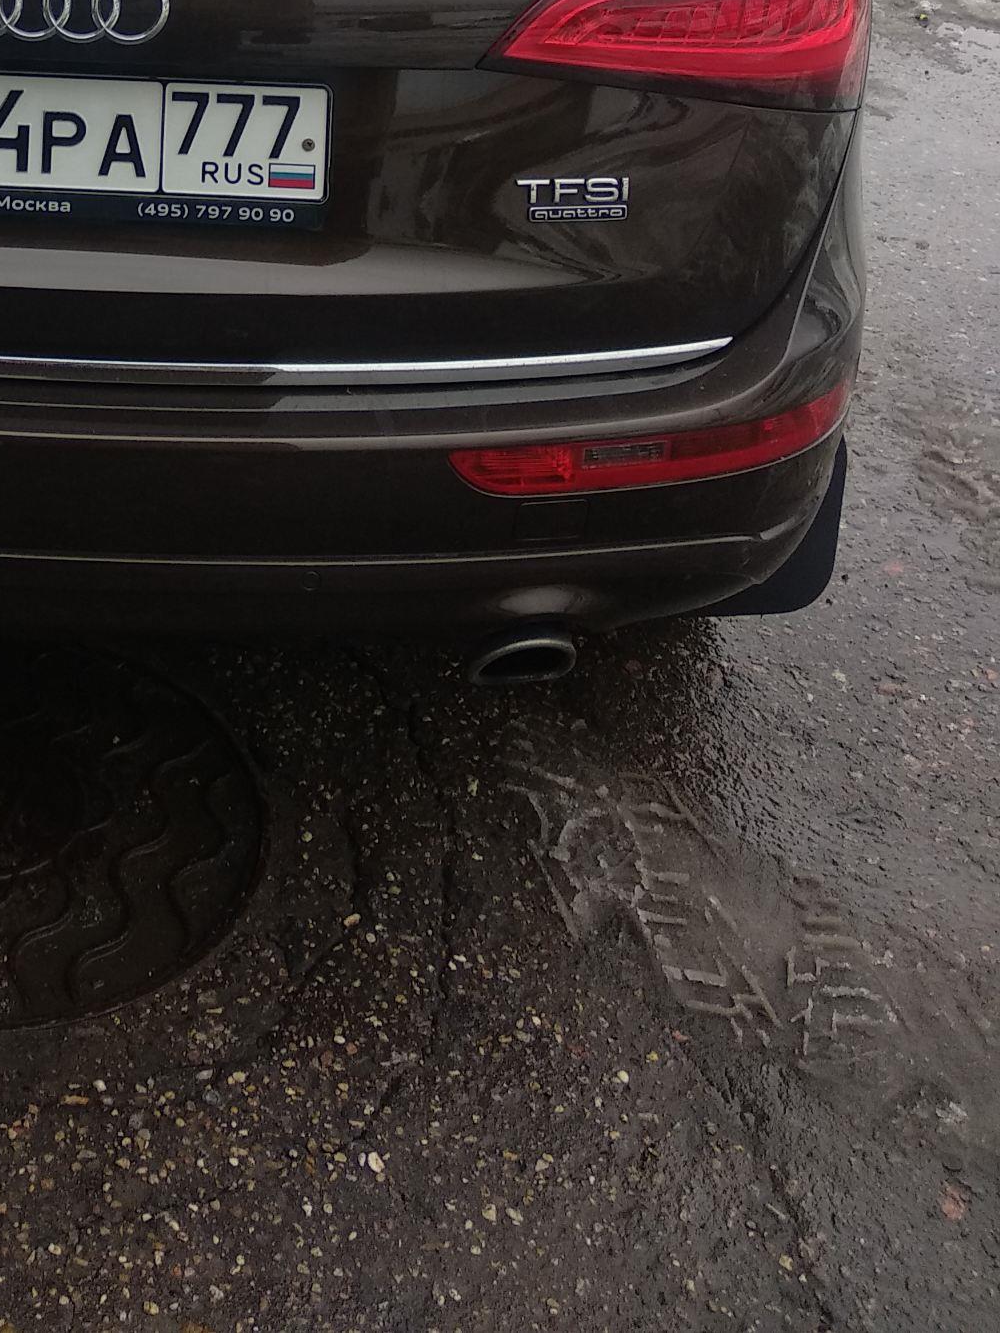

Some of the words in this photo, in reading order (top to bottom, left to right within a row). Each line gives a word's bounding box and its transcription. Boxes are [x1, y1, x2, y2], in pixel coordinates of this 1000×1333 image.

[171, 91, 301, 160] 777
[201, 161, 264, 186] RUS
[516, 176, 630, 204] TFSI
[137, 202, 189, 219] (495)
[195, 204, 232, 219] 797
[238, 207, 264, 221] 90
[269, 208, 295, 223] 90
[534, 208, 624, 222] quattro
